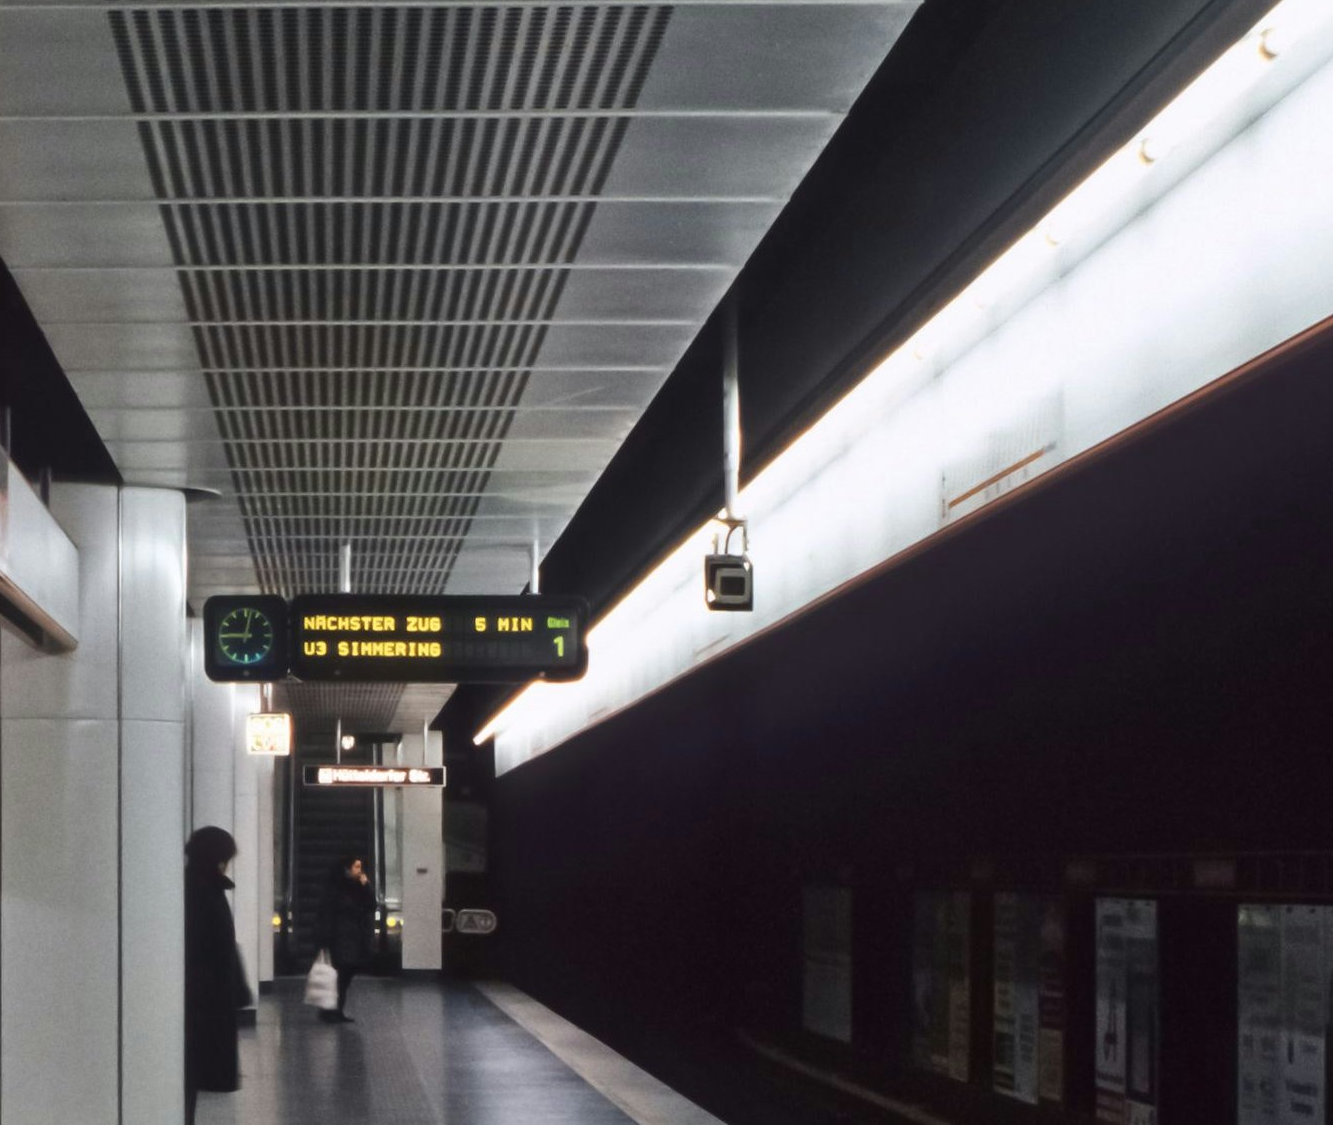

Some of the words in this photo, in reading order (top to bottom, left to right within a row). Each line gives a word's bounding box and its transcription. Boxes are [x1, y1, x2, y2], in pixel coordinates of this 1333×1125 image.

[303, 615, 395, 631] NÄCHSTER
[406, 616, 442, 632] ZUG
[475, 617, 487, 632] 5
[498, 617, 533, 631] MIN
[303, 641, 327, 656] U3
[338, 641, 442, 657] SIMMERING
[553, 635, 564, 657] 1
